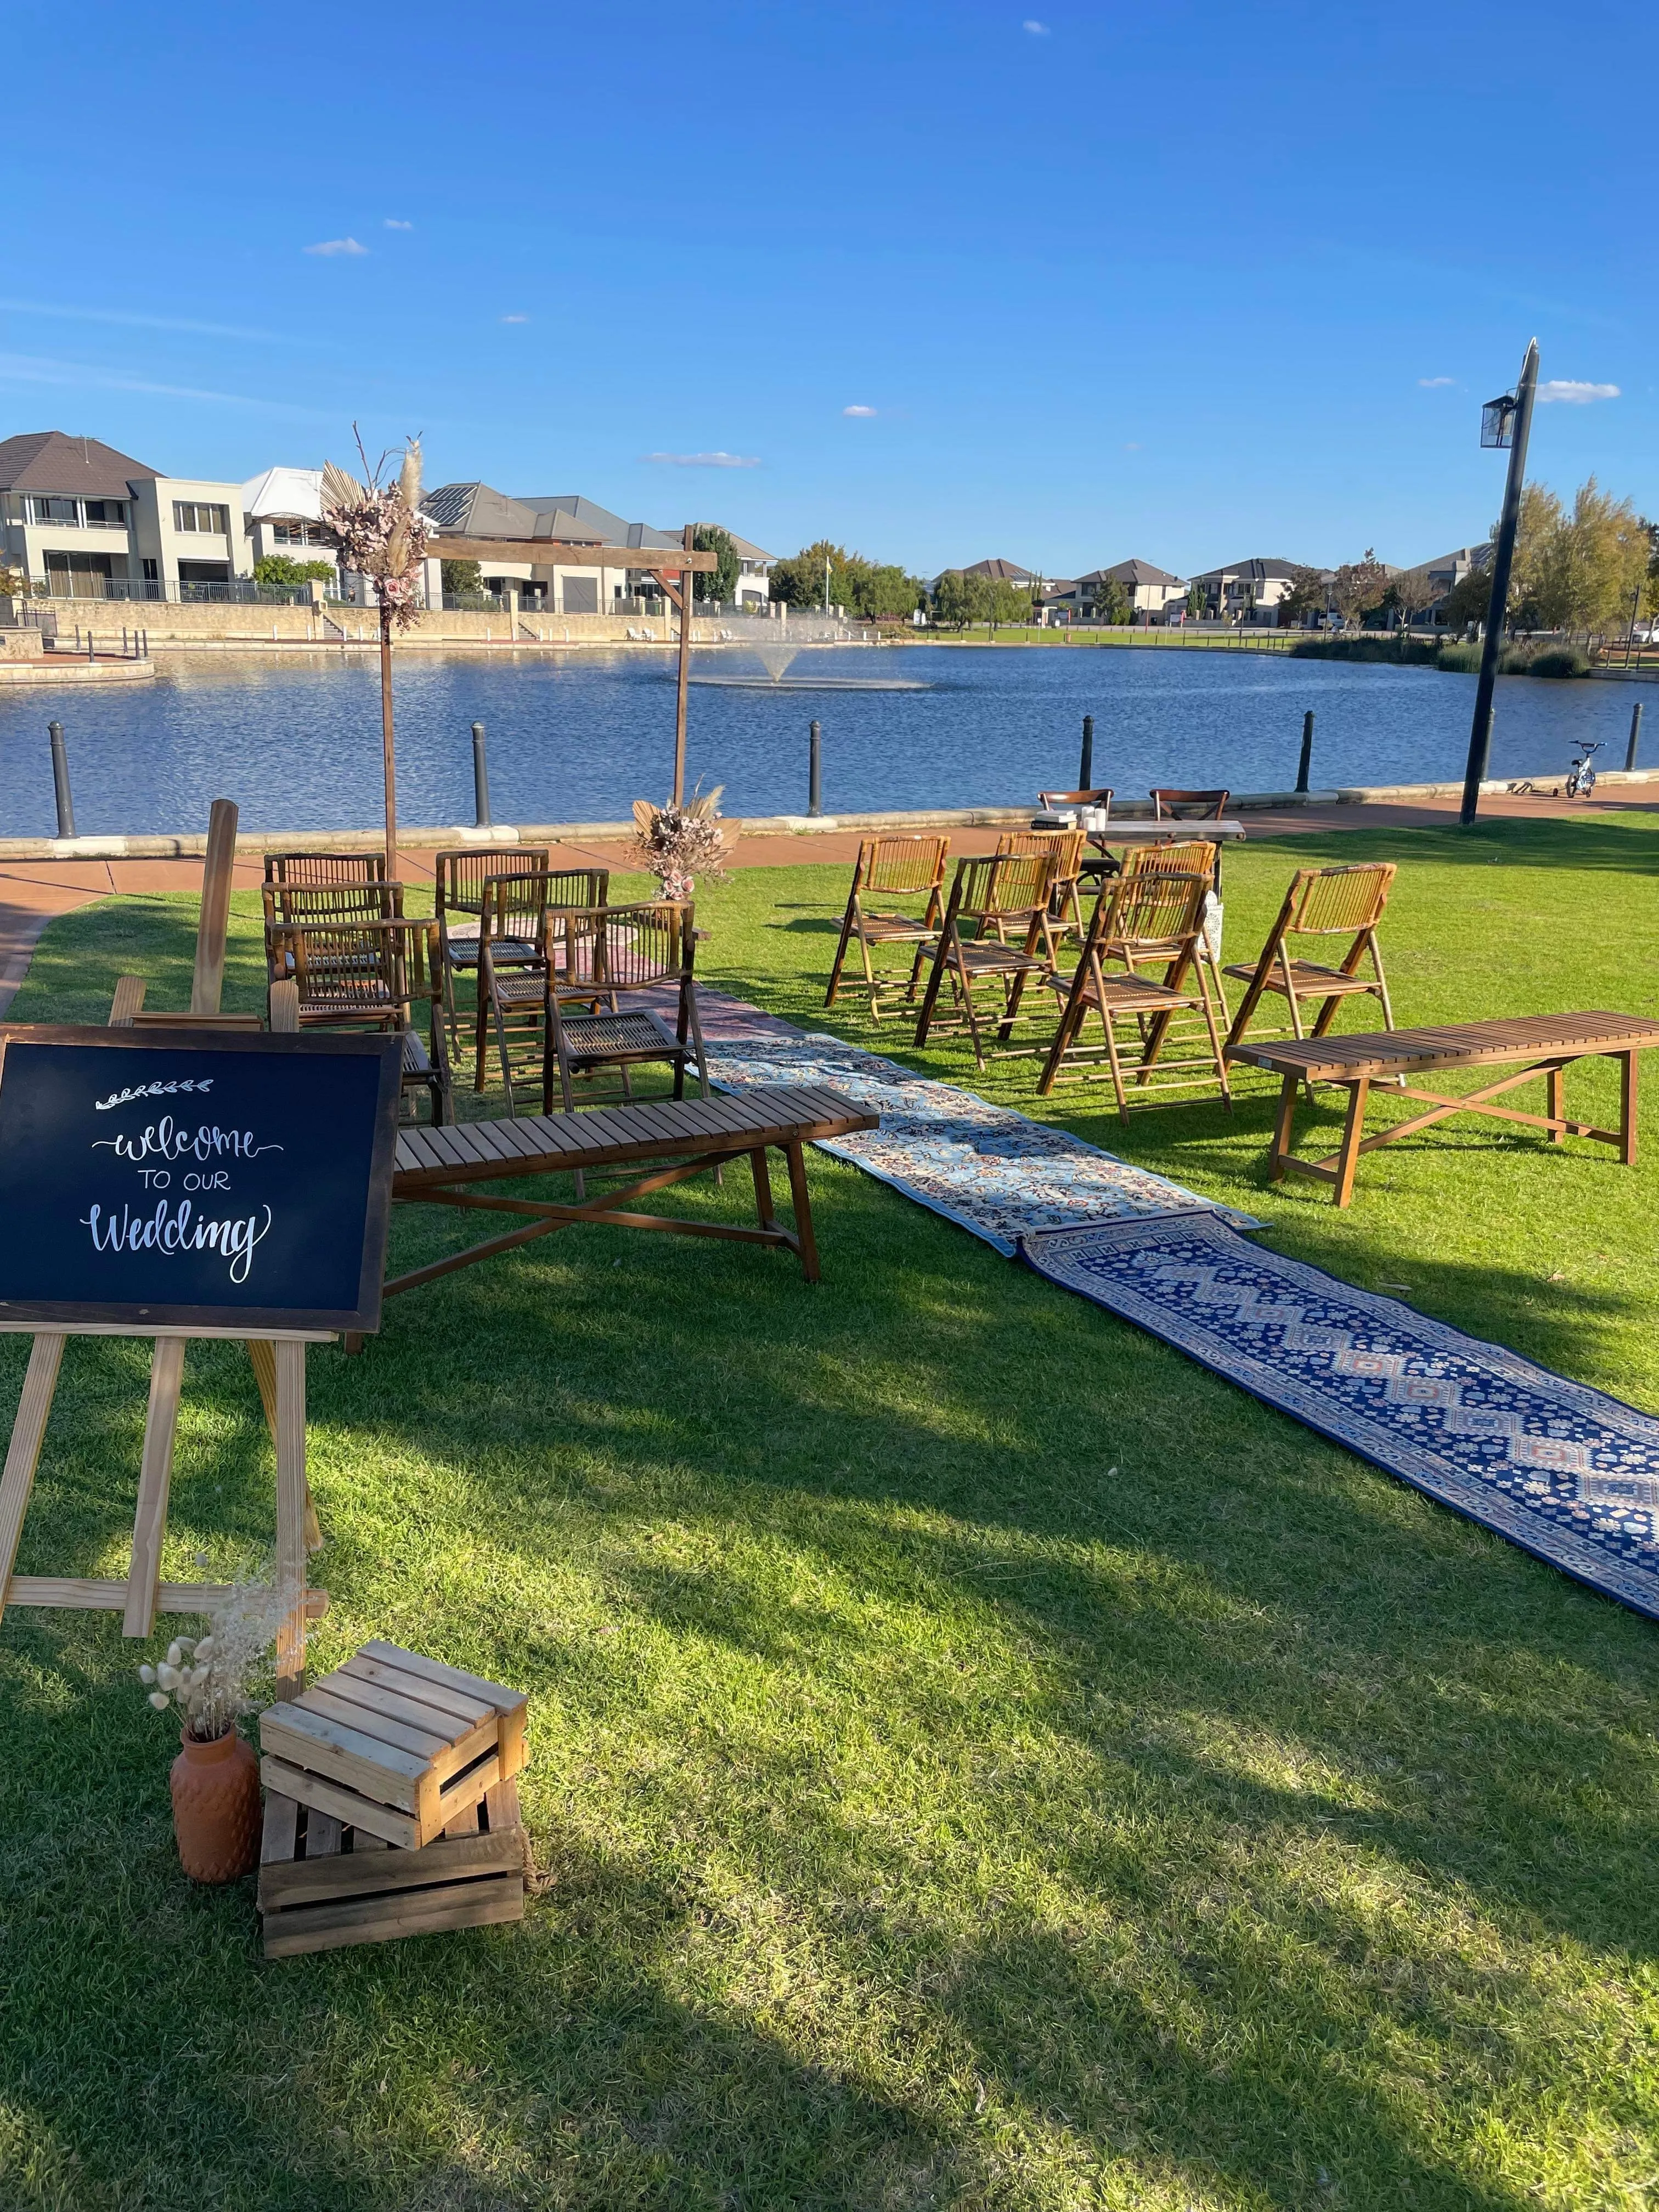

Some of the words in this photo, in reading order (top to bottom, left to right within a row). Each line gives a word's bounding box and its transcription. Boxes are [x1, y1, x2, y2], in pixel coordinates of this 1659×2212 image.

[137, 1169, 171, 1189] TO
[183, 1171, 231, 1191] OUR
[80, 1199, 272, 1284] Wedding
